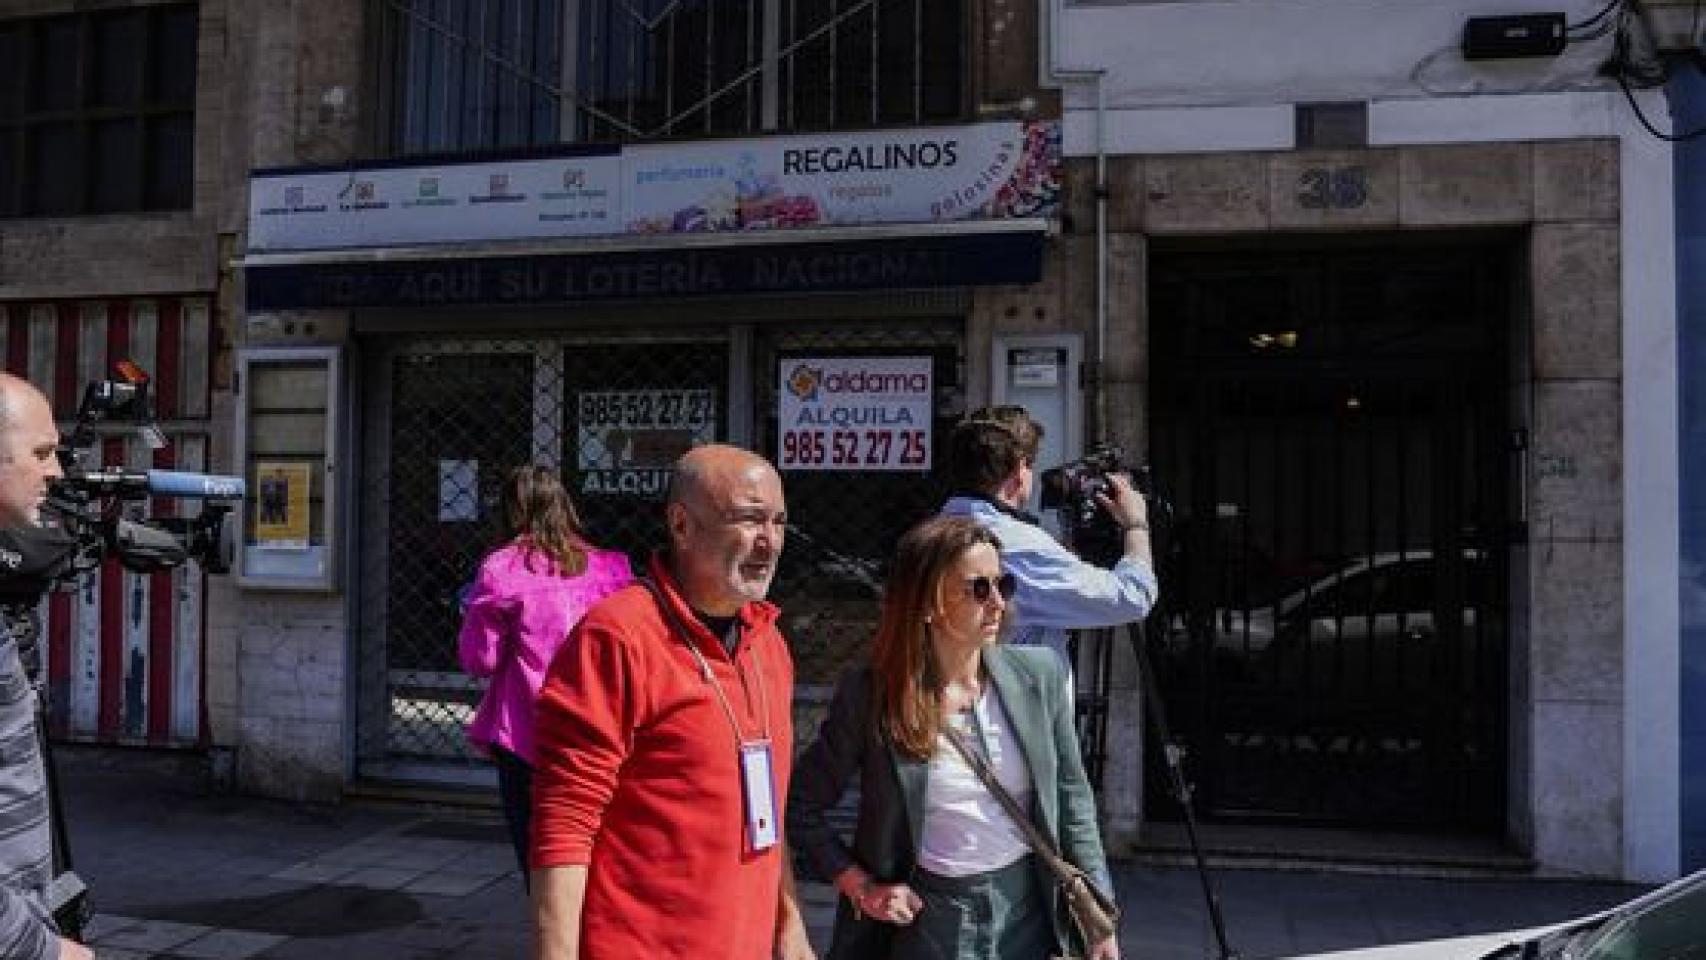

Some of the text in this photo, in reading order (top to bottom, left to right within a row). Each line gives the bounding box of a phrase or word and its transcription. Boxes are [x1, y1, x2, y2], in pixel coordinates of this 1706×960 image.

[783, 140, 957, 176] REGALINOS
[824, 370, 927, 393] aldama
[796, 407, 914, 428] ALQUILA
[783, 430, 926, 464] 985 52 27 25
[583, 471, 669, 494] ALQUI
